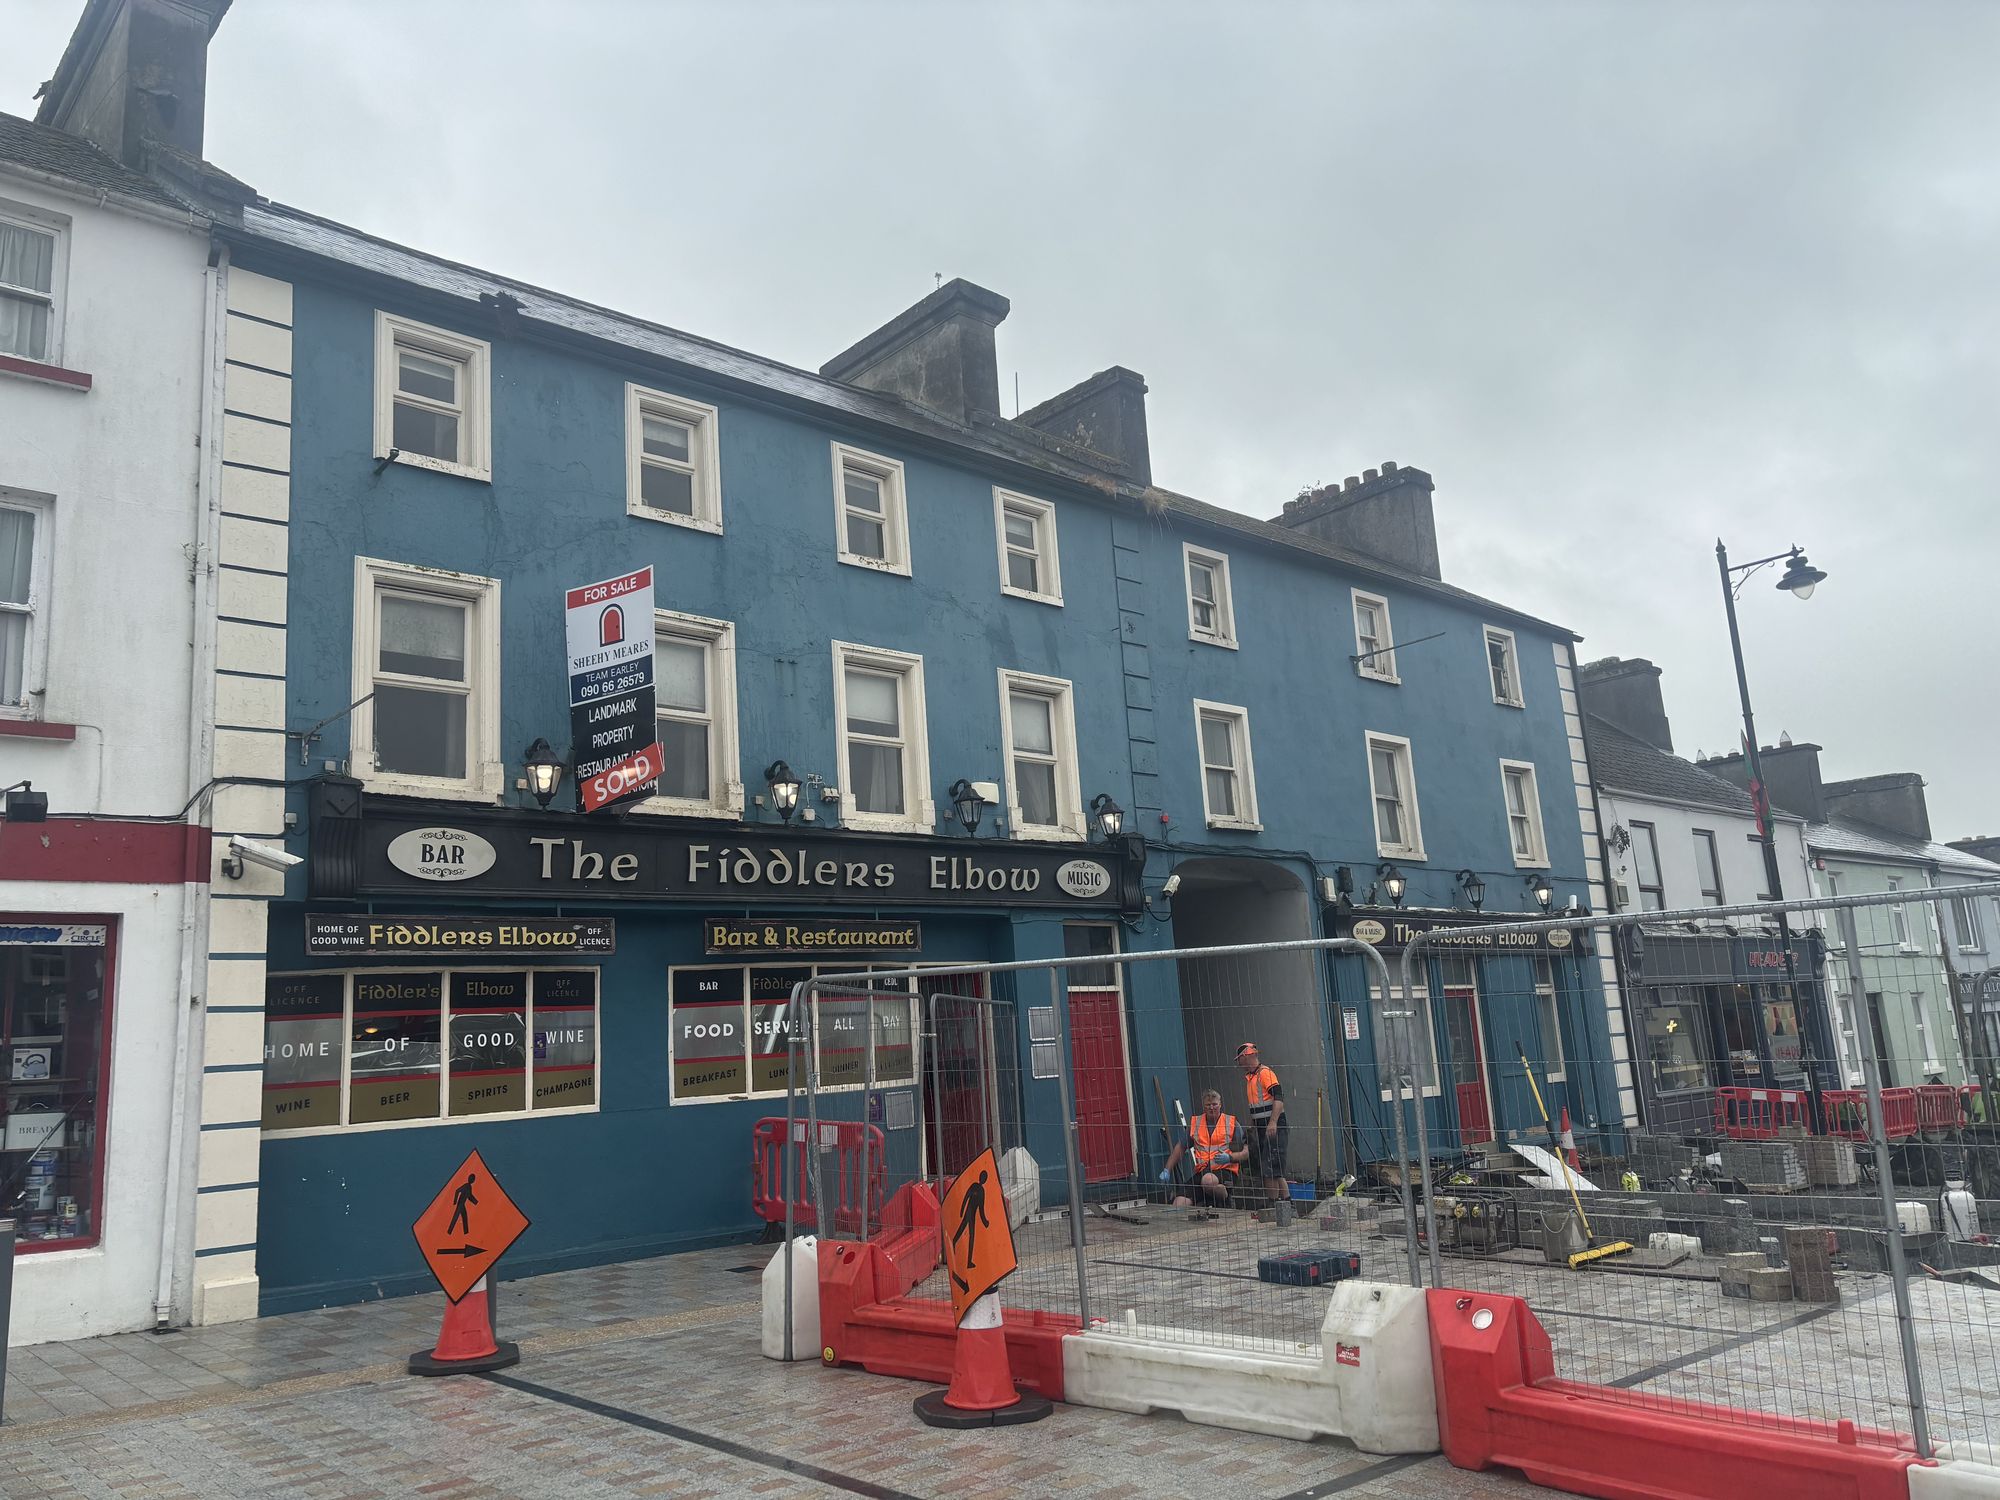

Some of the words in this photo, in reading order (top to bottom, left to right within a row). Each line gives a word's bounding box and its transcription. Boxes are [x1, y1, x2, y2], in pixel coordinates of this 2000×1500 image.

[584, 586, 608, 602] FOR
[610, 577, 637, 595] SALE
[573, 651, 611, 669] SHEEHY
[613, 640, 649, 659] MEARES
[586, 671, 609, 683] TEAM
[611, 662, 640, 678] EARLEY
[581, 684, 600, 697] 090
[602, 680, 615, 693] 66
[617, 671, 645, 689] 26579
[588, 697, 638, 723] LANDMARK
[592, 724, 635, 748] PROPERTY
[593, 756, 650, 802] SOLD
[420, 843, 465, 865] BAR
[529, 837, 639, 881] The
[687, 844, 895, 887] Fiddlers
[929, 855, 1040, 891] Elbow
[1066, 870, 1102, 887] MUSIC
[317, 925, 344, 934] HOME
[347, 925, 359, 934] OF
[369, 924, 493, 945] Fiddlers
[498, 925, 578, 945] Elbow
[587, 927, 602, 935] OFF
[713, 926, 759, 946] Bar
[763, 926, 779, 946] &
[785, 926, 915, 946] Restaurant
[1394, 923, 1423, 942] The
[311, 936, 340, 945] GOOD
[341, 936, 365, 945] WINE
[579, 937, 611, 946] LICENCE
[285, 985, 307, 994] OFF
[358, 984, 440, 1000] Fiddler's
[466, 981, 514, 996] Elbow
[556, 979, 571, 987] OFF
[699, 981, 719, 991] BAR
[270, 995, 320, 1006] LICENCE
[547, 989, 579, 998] LICENCE
[684, 1023, 734, 1039] FOOD
[754, 1020, 809, 1035] SERV
[833, 1017, 855, 1031] ALL
[882, 1015, 901, 1028] DAY
[264, 1042, 330, 1059] HOME
[384, 1037, 410, 1051] OF
[463, 1032, 515, 1048] GOOD
[545, 1030, 584, 1044] WINE
[683, 1069, 737, 1086] BREAKFAST
[769, 1066, 798, 1079] LUN
[275, 1098, 312, 1114] WINE
[380, 1092, 410, 1106] BEER
[468, 1084, 508, 1101] SPIRITS
[536, 1077, 593, 1097] CHAMPAGNE
[19, 1124, 56, 1135] BREAD
